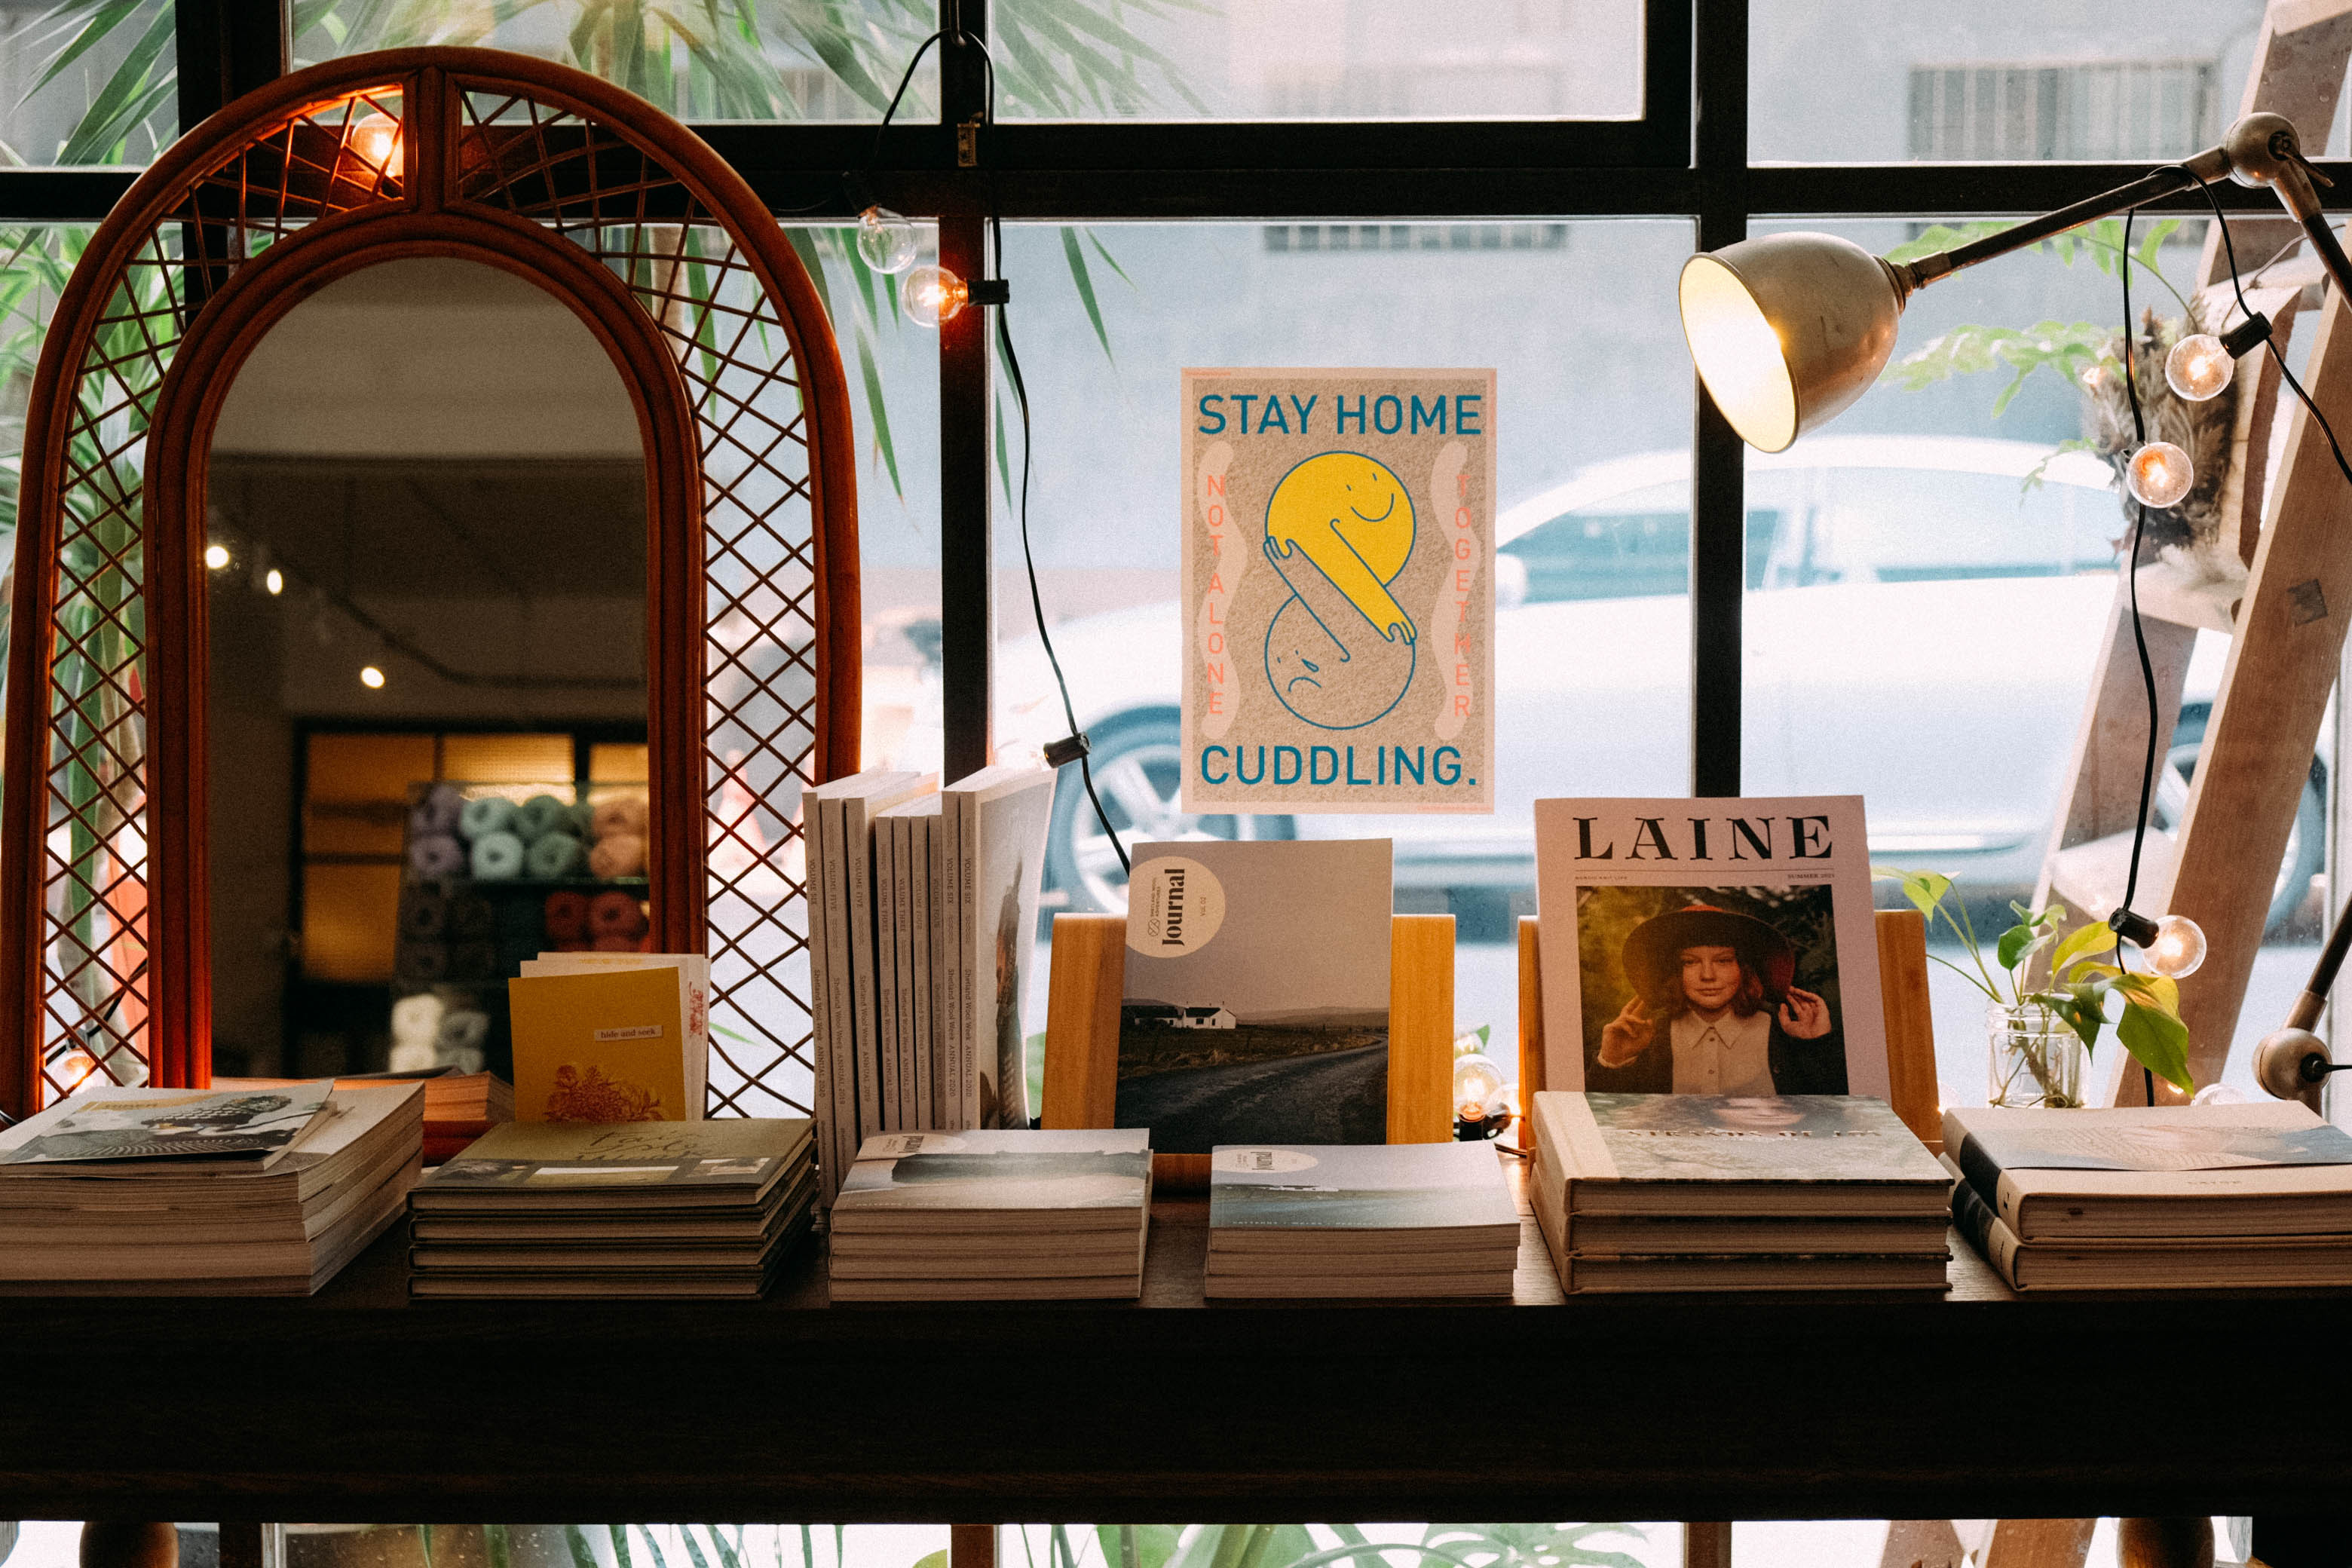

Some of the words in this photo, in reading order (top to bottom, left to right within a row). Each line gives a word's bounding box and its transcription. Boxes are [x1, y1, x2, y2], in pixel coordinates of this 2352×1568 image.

[1199, 394, 1318, 435] STAY
[1337, 394, 1481, 435] HOME
[1206, 474, 1226, 556] NOT
[1454, 474, 1471, 717] TOGETHER
[1207, 572, 1225, 715] ALONE
[1200, 745, 1477, 786] CUDDLING.
[1573, 815, 1833, 861] LAINE
[1162, 868, 1185, 946] Journal
[620, 1029, 636, 1038] and
[638, 1027, 656, 1037] seek
